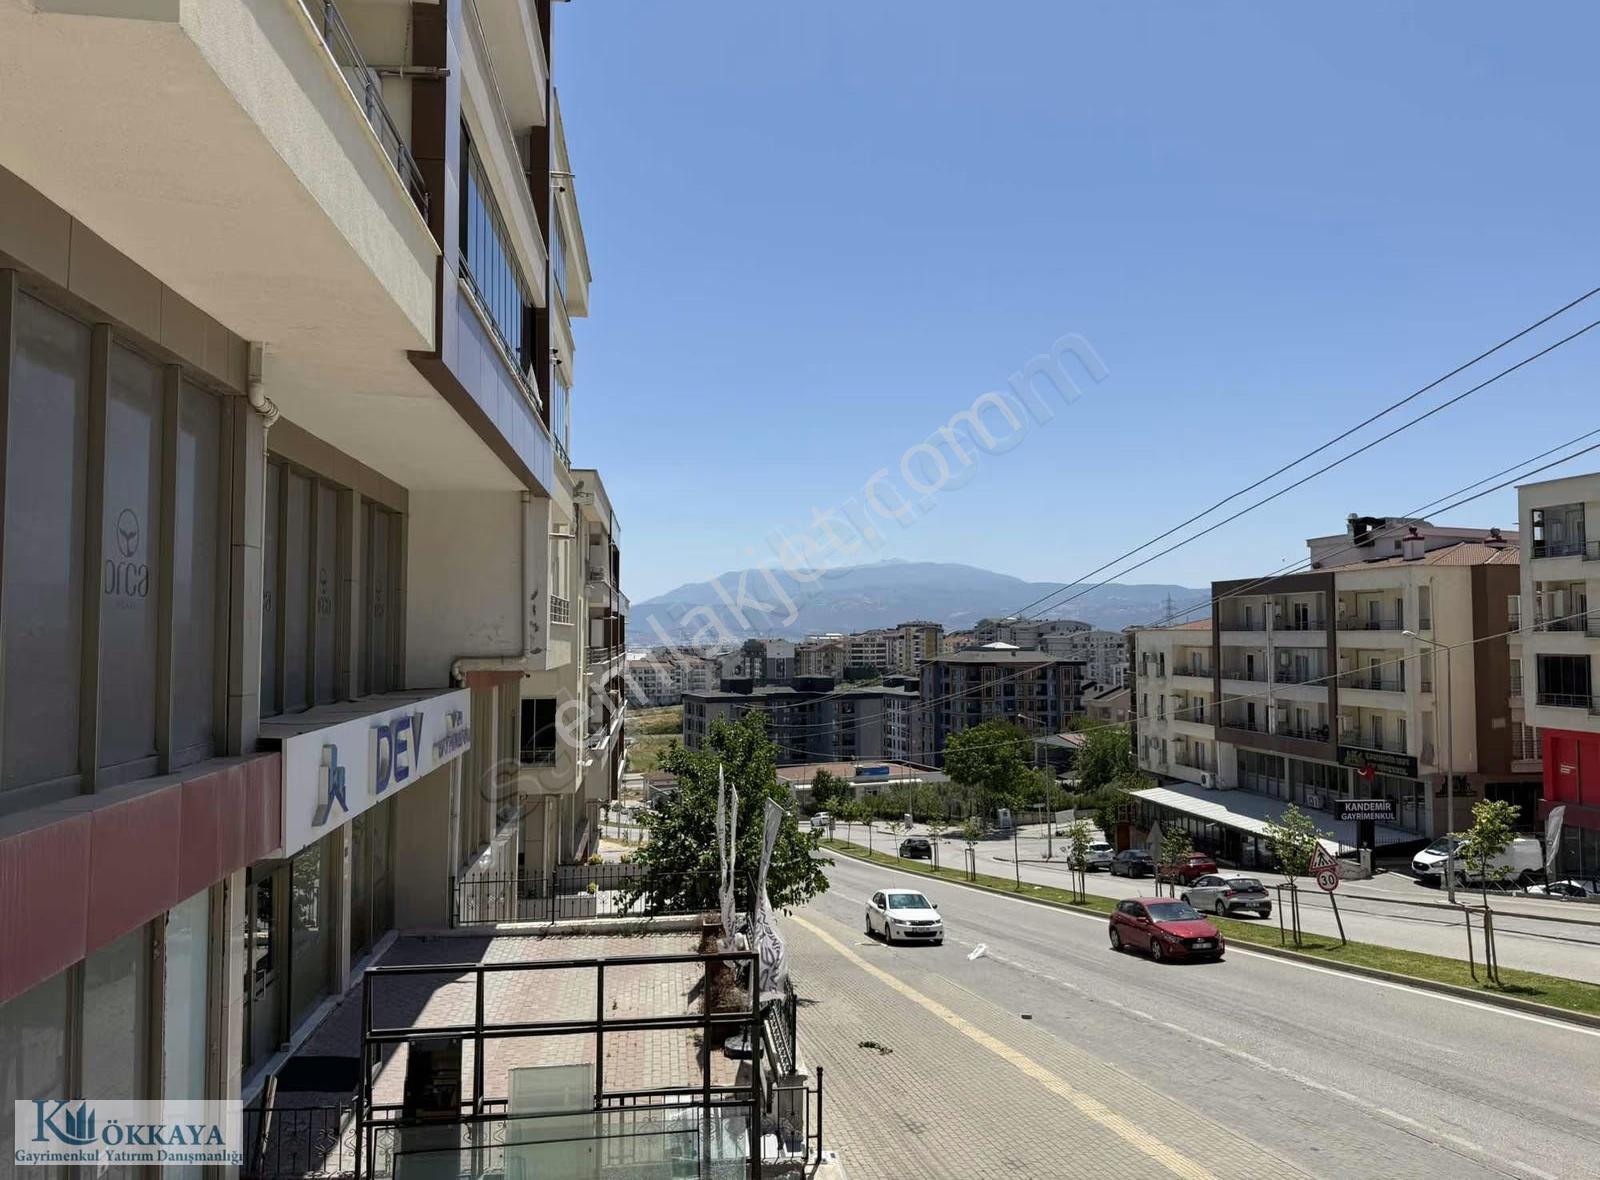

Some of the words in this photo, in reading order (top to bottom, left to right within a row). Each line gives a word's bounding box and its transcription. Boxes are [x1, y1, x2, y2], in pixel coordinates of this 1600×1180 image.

[369, 712, 424, 796] DEV
[1345, 802, 1392, 811] KANDEMİR
[1341, 811, 1395, 820] GAYRİMENKUL
[1321, 874, 1335, 887] 30
